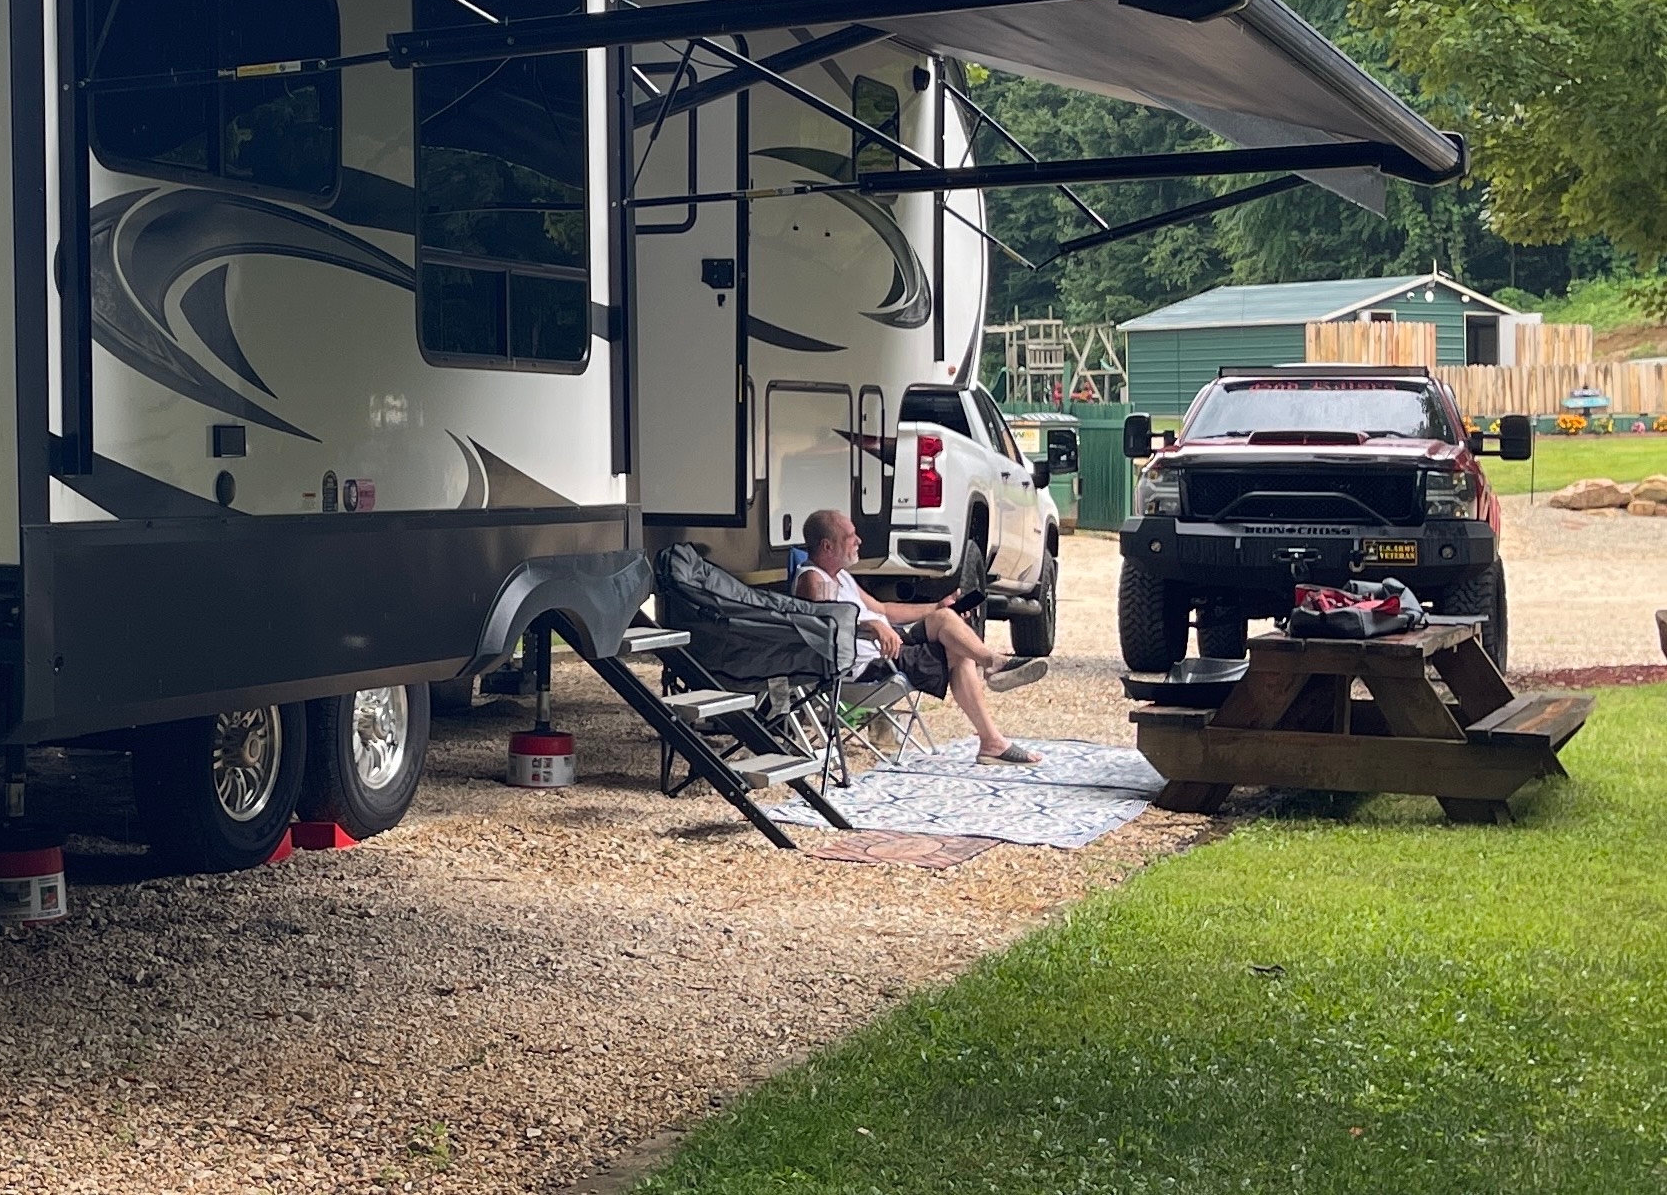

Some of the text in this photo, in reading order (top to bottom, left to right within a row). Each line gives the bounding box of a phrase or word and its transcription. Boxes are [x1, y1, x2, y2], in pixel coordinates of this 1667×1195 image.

[1244, 527, 1350, 536] IRON CROSS
[1379, 552, 1415, 560] VETERAN
